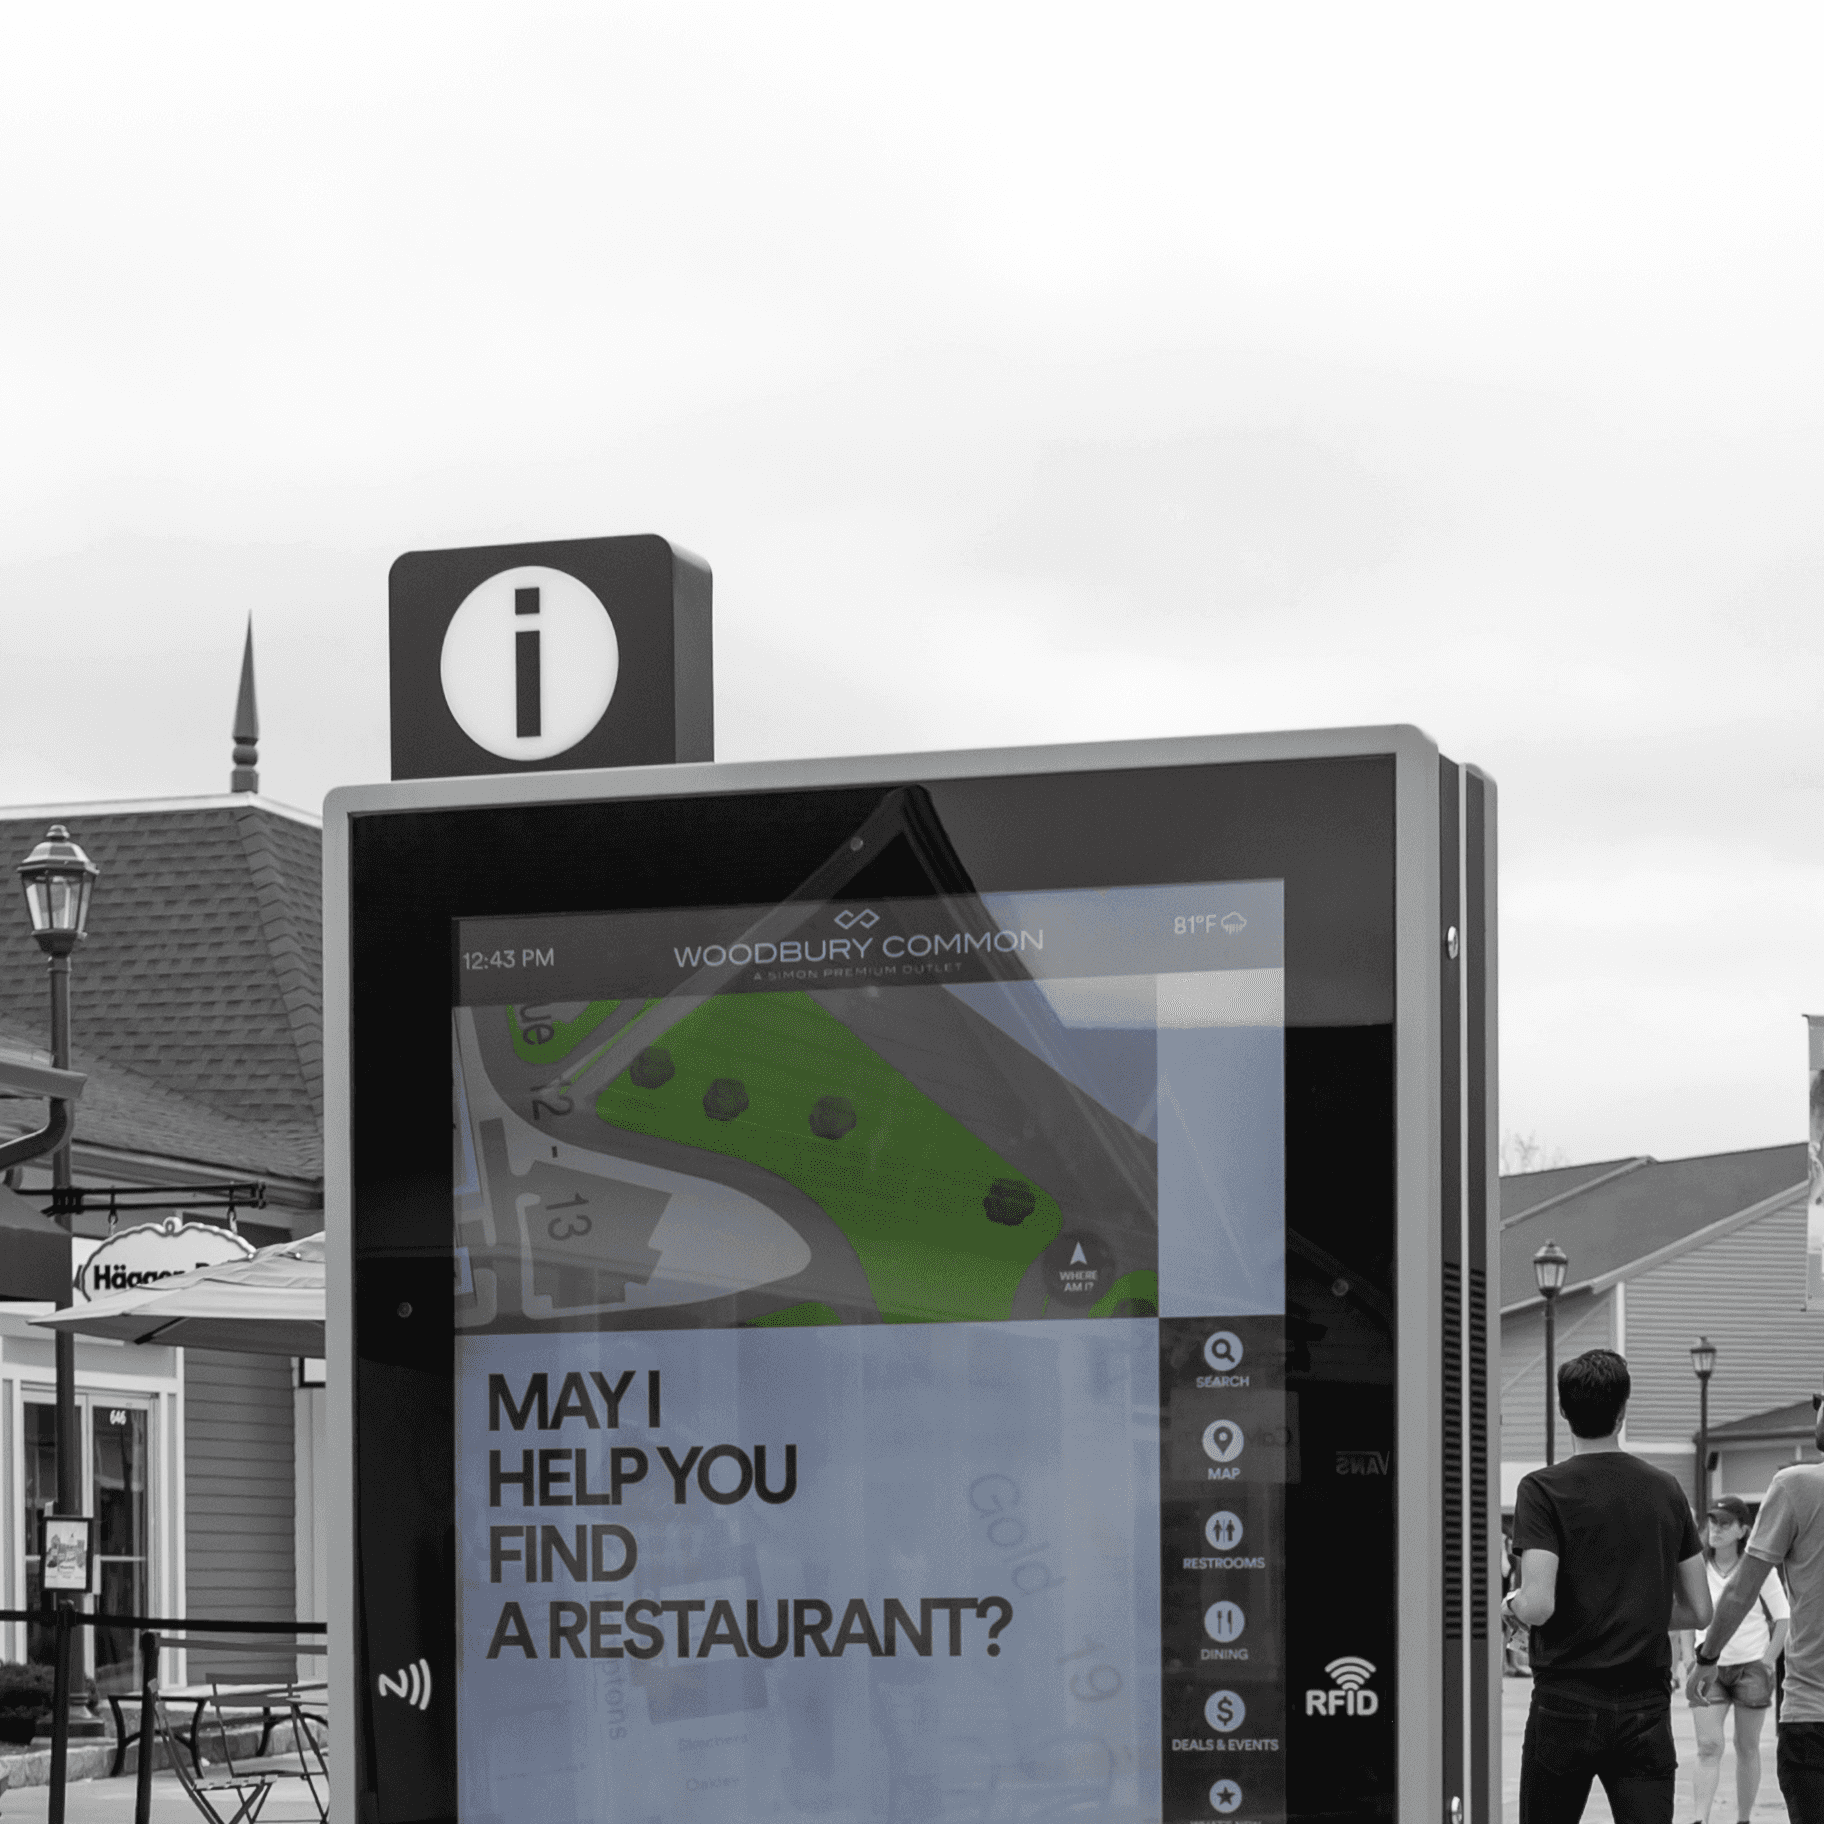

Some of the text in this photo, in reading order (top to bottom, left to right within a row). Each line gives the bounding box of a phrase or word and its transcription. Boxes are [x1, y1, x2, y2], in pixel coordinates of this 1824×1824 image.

[674, 929, 1045, 968] WOODBURY COMMON
[463, 947, 555, 970] 12:43 PM
[753, 962, 963, 981] A SIMON PREMIUM OUTLET
[1059, 1270, 1098, 1281] WHERE
[1064, 1281, 1083, 1292] AM
[1196, 1376, 1250, 1389] SEARCH
[488, 1369, 661, 1431] MAY I
[488, 1444, 798, 1507] HELP YOU
[1207, 1467, 1241, 1480] MAP
[489, 1523, 638, 1583] FIND
[1182, 1557, 1266, 1570] RESTROOMS
[486, 1596, 1014, 1660] A RESTAURANT?
[1200, 1648, 1249, 1661] DINING
[1305, 1689, 1379, 1717] RFID
[1172, 1739, 1280, 1752] DEALS & EVENTS
